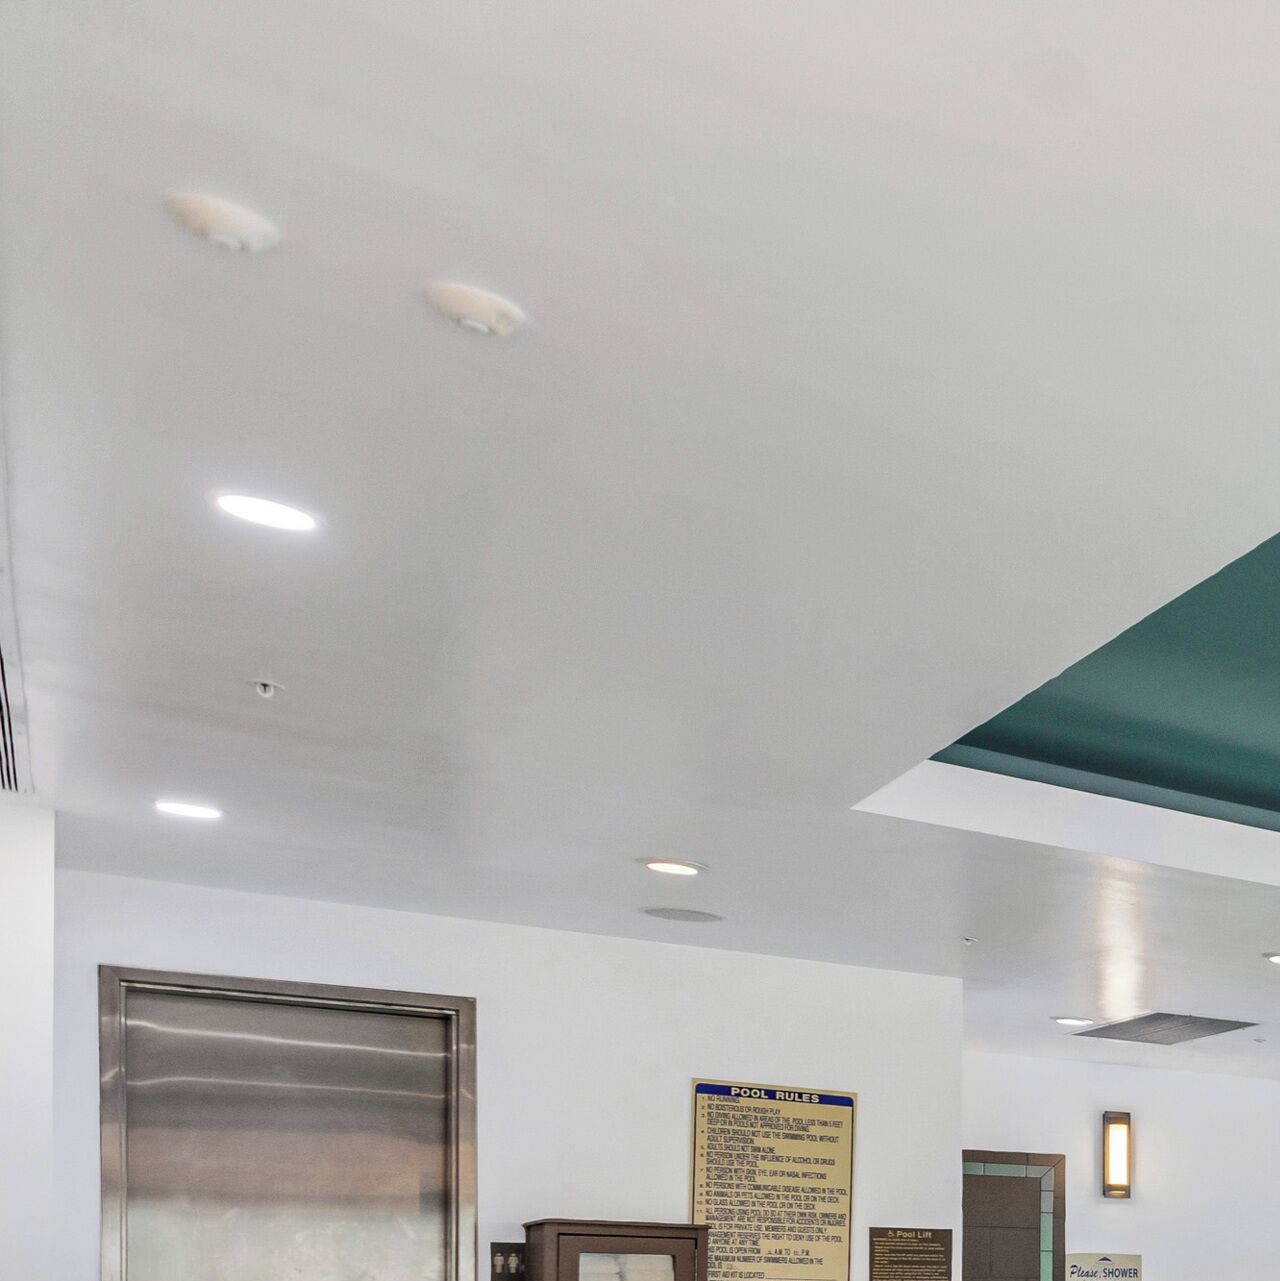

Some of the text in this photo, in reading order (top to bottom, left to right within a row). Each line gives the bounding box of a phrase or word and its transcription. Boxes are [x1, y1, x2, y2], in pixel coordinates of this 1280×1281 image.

[731, 1087, 819, 1103] POOL RULES
[897, 1230, 915, 1238] Pool
[1070, 1264, 1138, 1278] Please SHOWER
